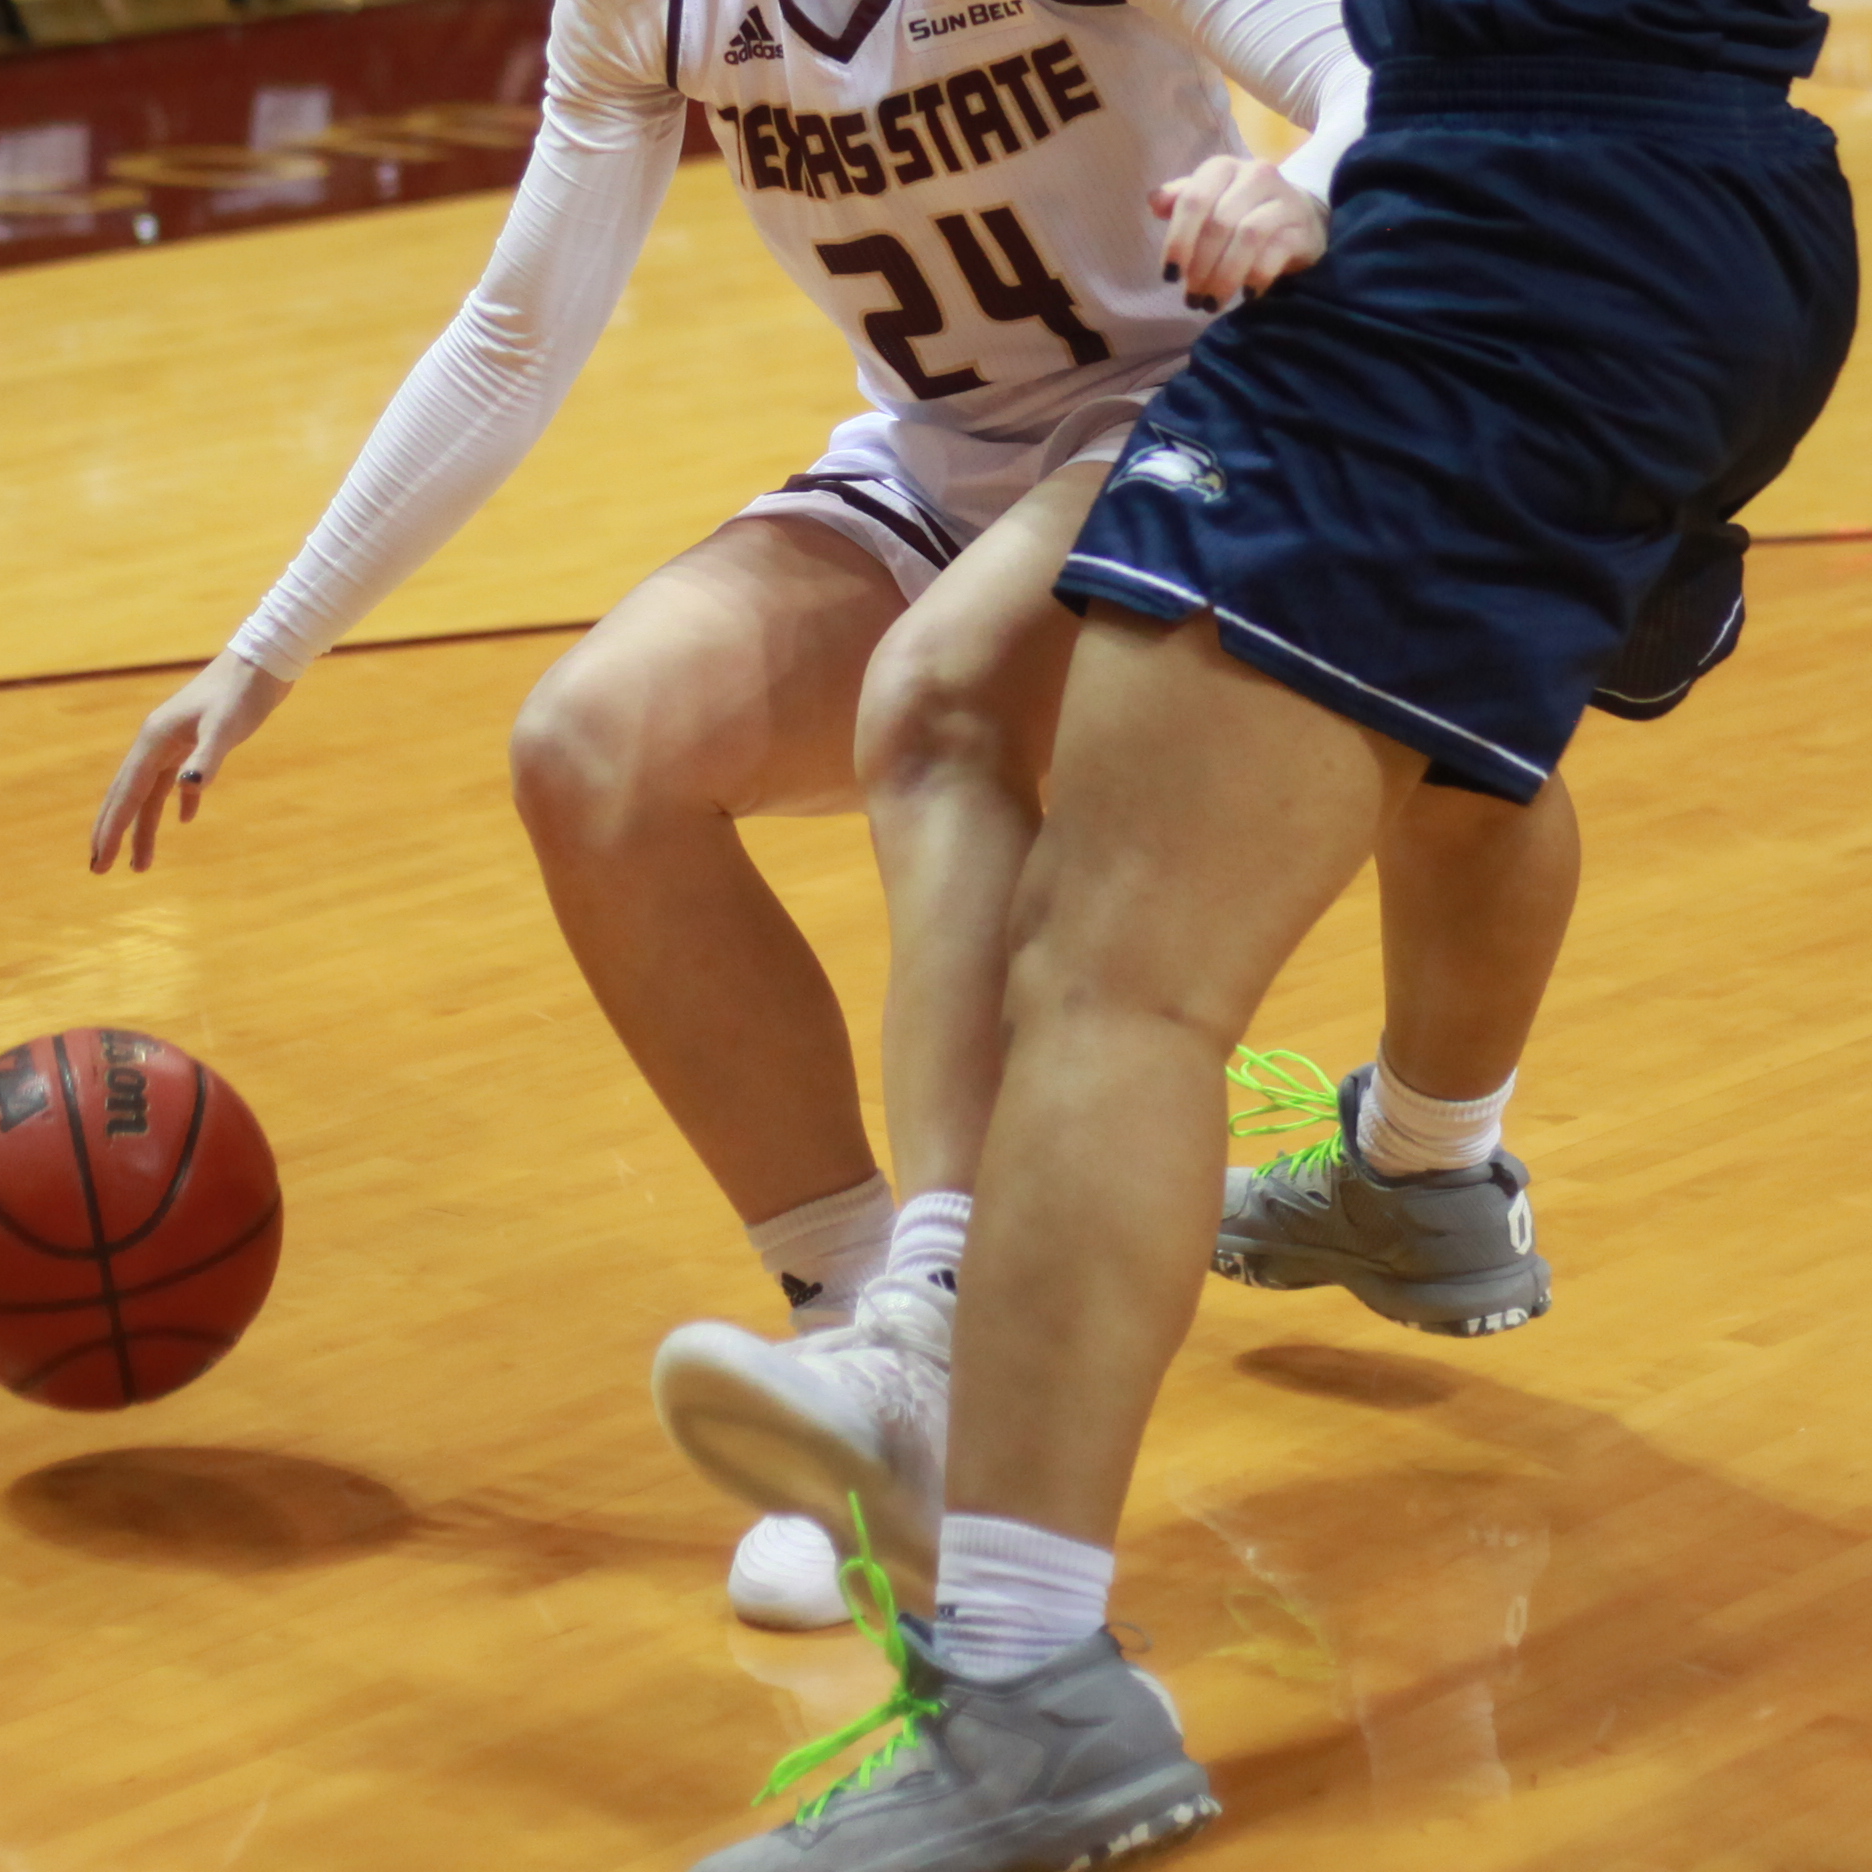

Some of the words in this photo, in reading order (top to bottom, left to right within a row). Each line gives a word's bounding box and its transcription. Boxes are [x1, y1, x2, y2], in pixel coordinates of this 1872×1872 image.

[724, 39, 784, 66] adidas
[877, 34, 1105, 187] STATE
[811, 200, 1114, 402] 24
